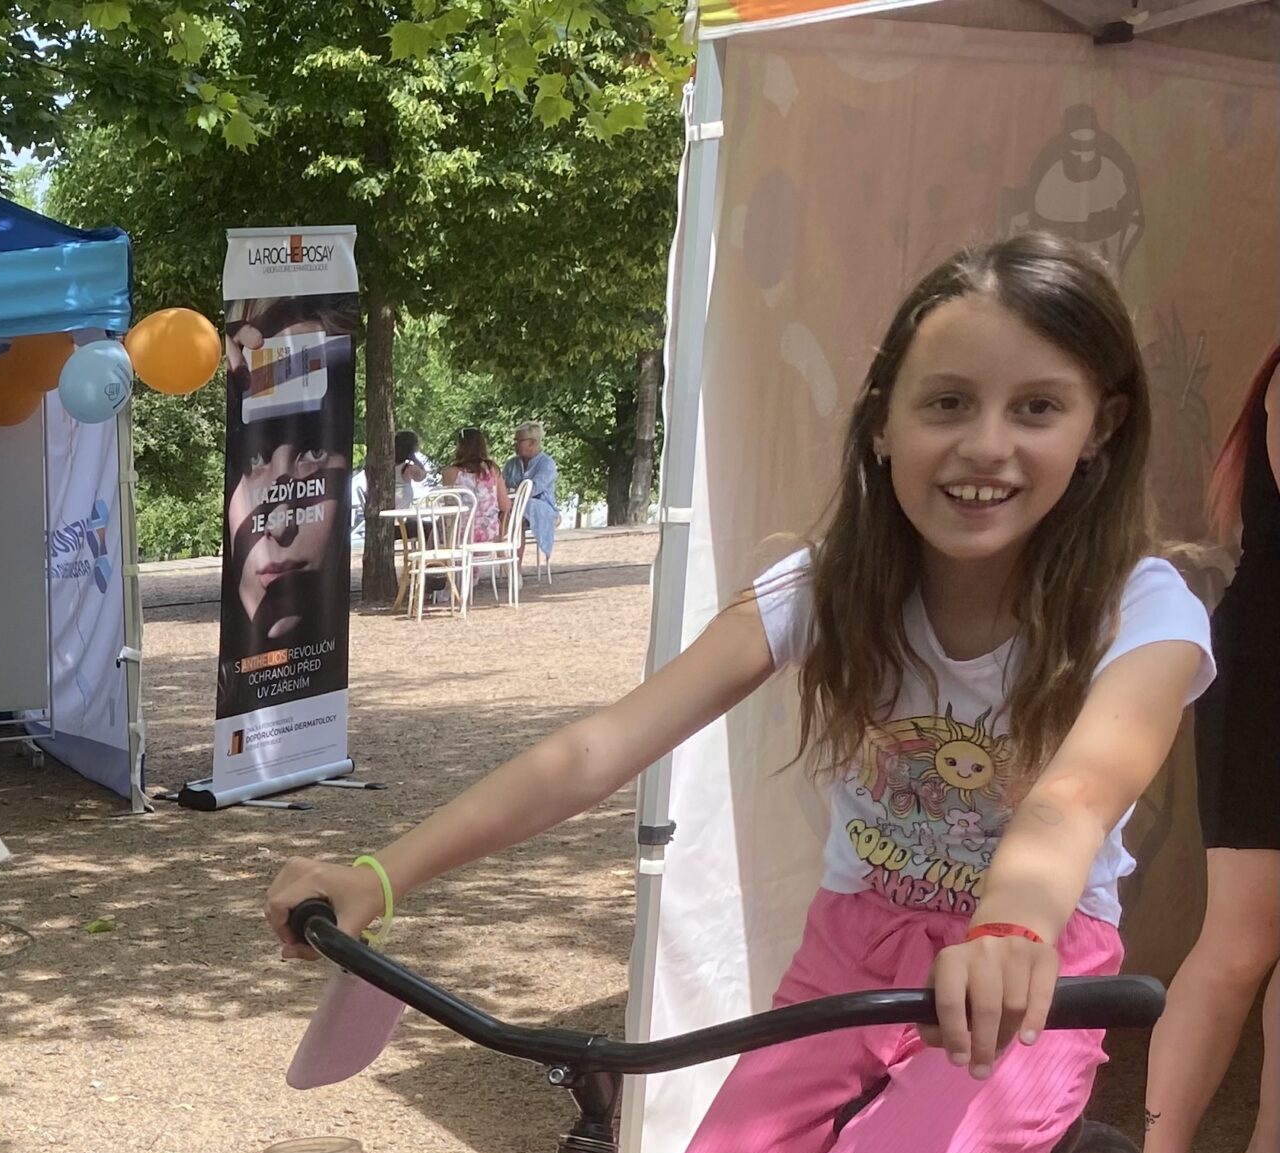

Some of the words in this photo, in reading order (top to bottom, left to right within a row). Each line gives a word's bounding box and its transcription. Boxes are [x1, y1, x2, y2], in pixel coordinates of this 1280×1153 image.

[296, 478, 326, 499] DEN
[251, 514, 265, 534] JE
[296, 504, 325, 525] DEN
[234, 661, 241, 674] S
[288, 638, 335, 660] REVOLUČNÍ
[248, 664, 297, 685] OCHRANOU
[297, 657, 321, 674] PŘED
[257, 685, 269, 699] UV
[270, 675, 311, 696] ZÁŘENÍM
[245, 724, 294, 744] DOPORUČOVANÁ
[862, 864, 977, 918] AHEAD
